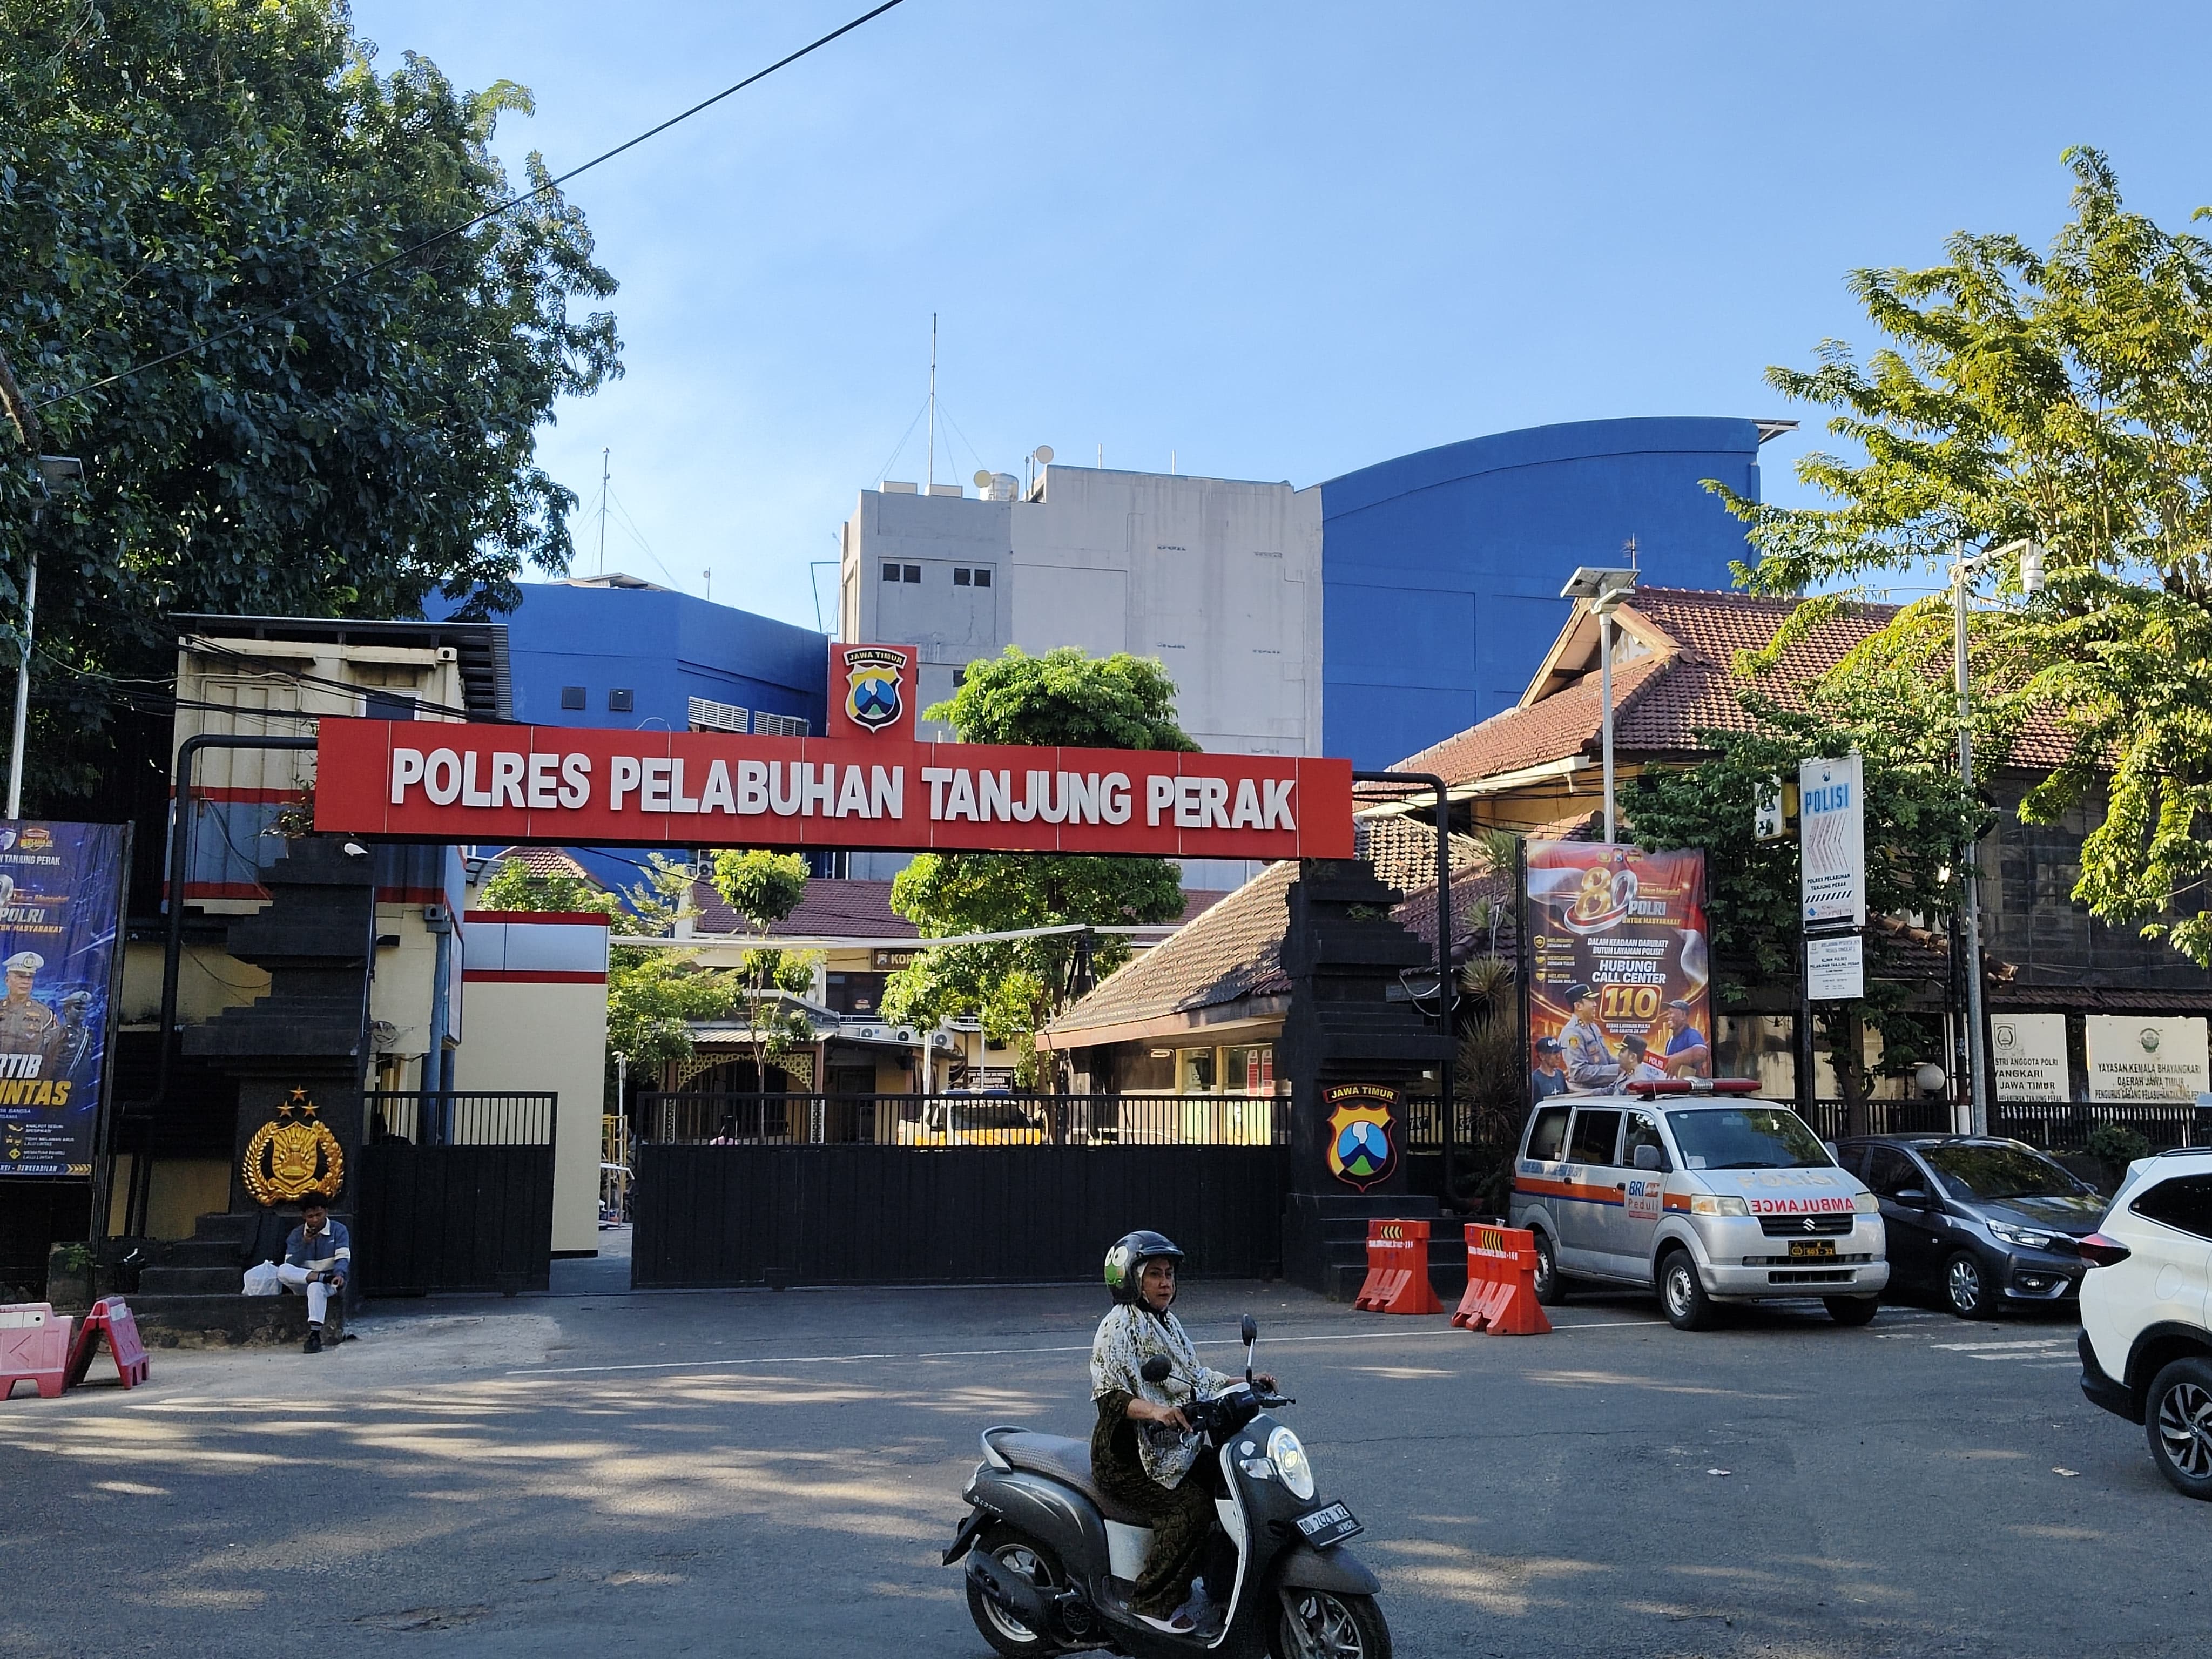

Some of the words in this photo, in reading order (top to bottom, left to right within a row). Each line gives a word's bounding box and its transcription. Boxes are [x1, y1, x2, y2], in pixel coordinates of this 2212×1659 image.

[849, 651, 873, 661] JAWA
[874, 651, 903, 664] TIMUR
[390, 748, 591, 810] POLRES
[611, 757, 904, 819] PELABUHAN
[921, 767, 1131, 825] TANJUNG
[1146, 775, 1296, 831] PERAK
[1805, 784, 1849, 815] POLISI
[36, 856, 61, 865] PERAK
[1627, 900, 1667, 916] POLRI
[0, 908, 45, 923] POLRI
[1587, 937, 1609, 946] DALAM
[1609, 938, 1638, 947] KEADAAN
[1593, 946, 1613, 955] BUTUH
[1613, 946, 1641, 955] LAYANAN
[1599, 959, 1657, 973] HUBUNGI
[1591, 971, 1621, 983] CALL
[1622, 973, 1667, 984] CENTER
[1604, 987, 1657, 1018] 110
[0, 1053, 43, 1079] RTIB
[1995, 1058, 2008, 1066] STRI
[2010, 1058, 2040, 1066] ANGGOTA
[2041, 1058, 2059, 1066] POLRI
[2098, 1063, 2128, 1073] YAYASAN
[2129, 1063, 2156, 1074] KEMALA
[2157, 1063, 2201, 1074] BHAYANGKARI
[2000, 1081, 2025, 1089] JAWA
[2027, 1081, 2055, 1089] TIMUR
[2117, 1076, 2144, 1087] DAERAH
[2145, 1077, 2163, 1087] JAWA
[2164, 1077, 2184, 1087] TIMUR
[0, 1079, 72, 1106] INTAS
[1331, 1087, 1359, 1098] JAWA
[1361, 1086, 1394, 1100] TIMUR
[1629, 1181, 1645, 1197] BRI
[1628, 1198, 1659, 1211] Peduli
